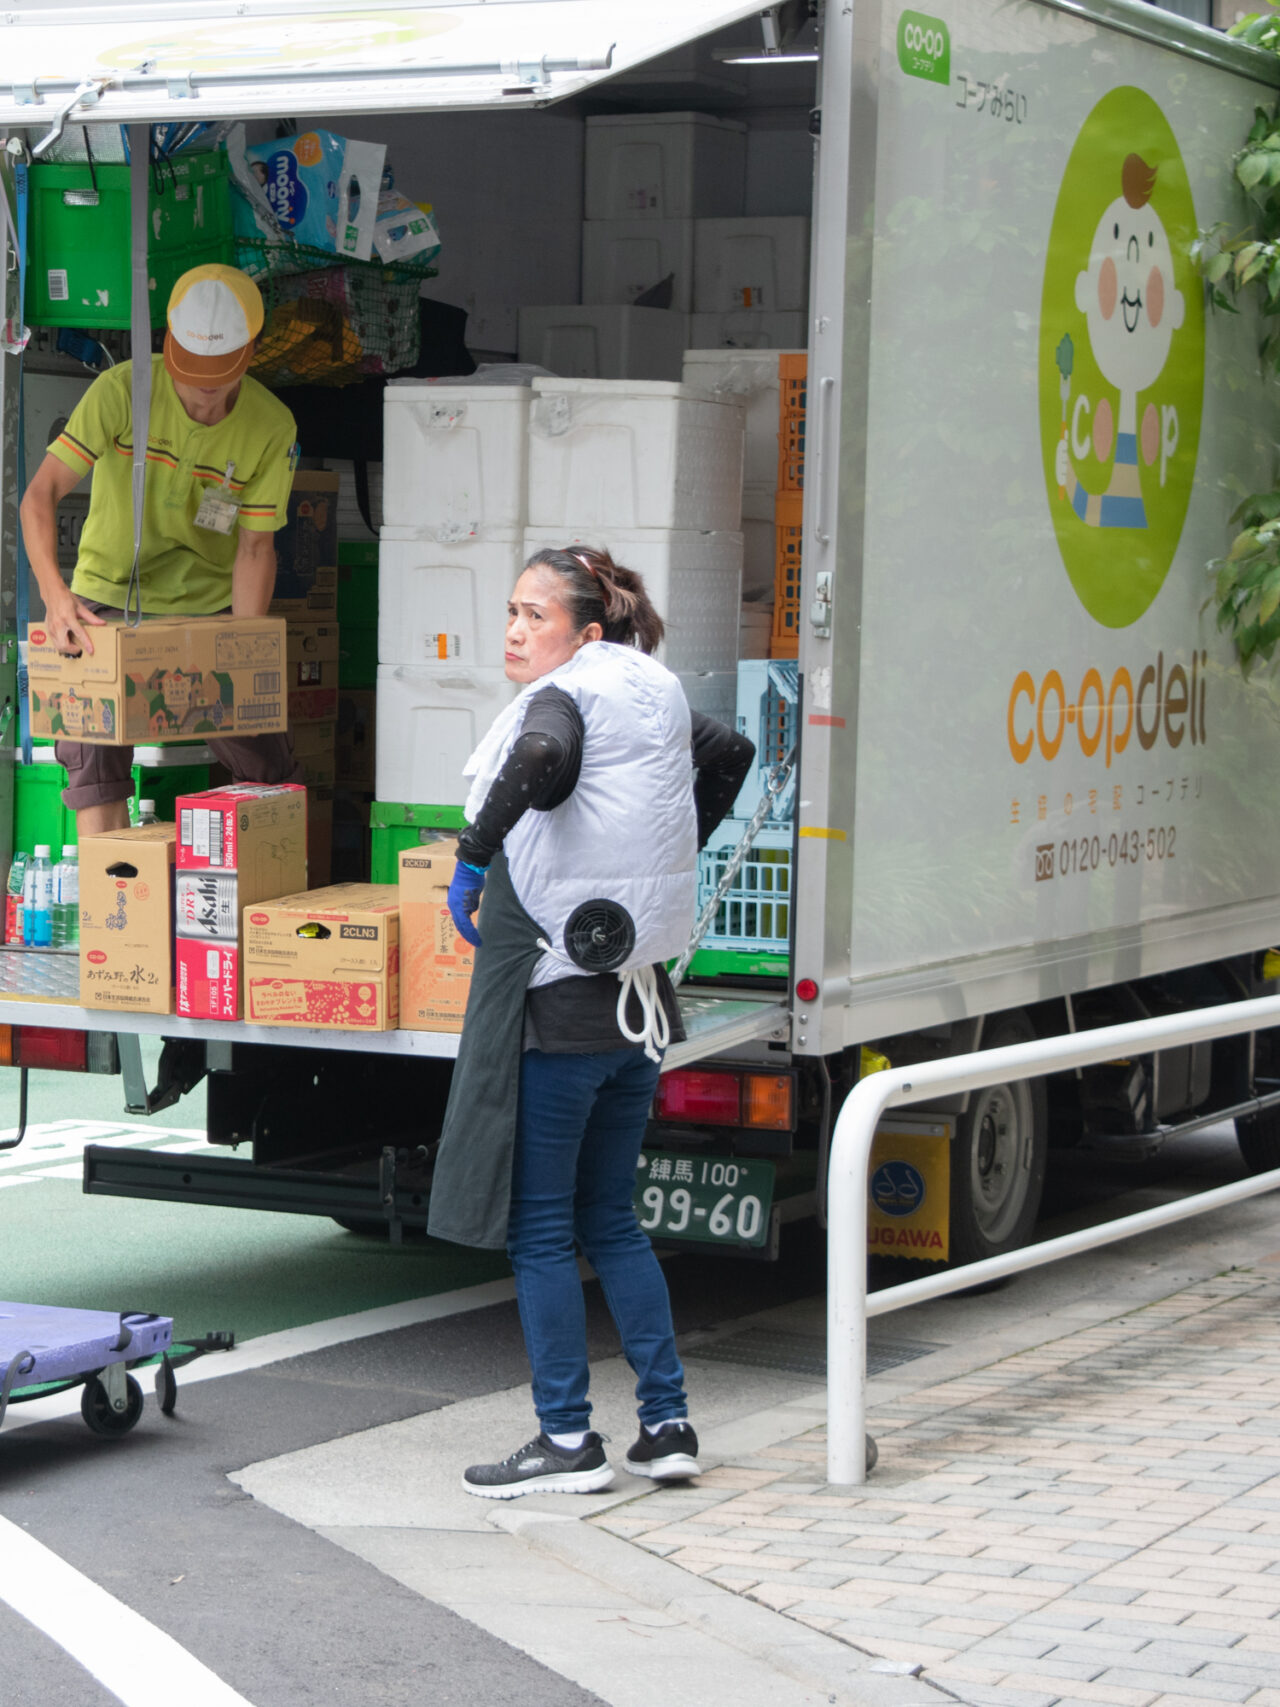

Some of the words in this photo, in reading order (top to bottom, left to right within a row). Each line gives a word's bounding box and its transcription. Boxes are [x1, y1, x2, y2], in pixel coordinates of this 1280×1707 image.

[956, 75, 1028, 125] コープみらい
[1059, 825, 1177, 876] 0120-043-502
[196, 877, 219, 935] Asahi
[221, 898, 230, 914] 生
[343, 927, 376, 939] 2CLN3
[223, 951, 233, 1016] スーパードライ
[649, 1157, 694, 1183] 練馬
[701, 1161, 739, 1187] 100
[640, 1186, 762, 1239] 99-60
